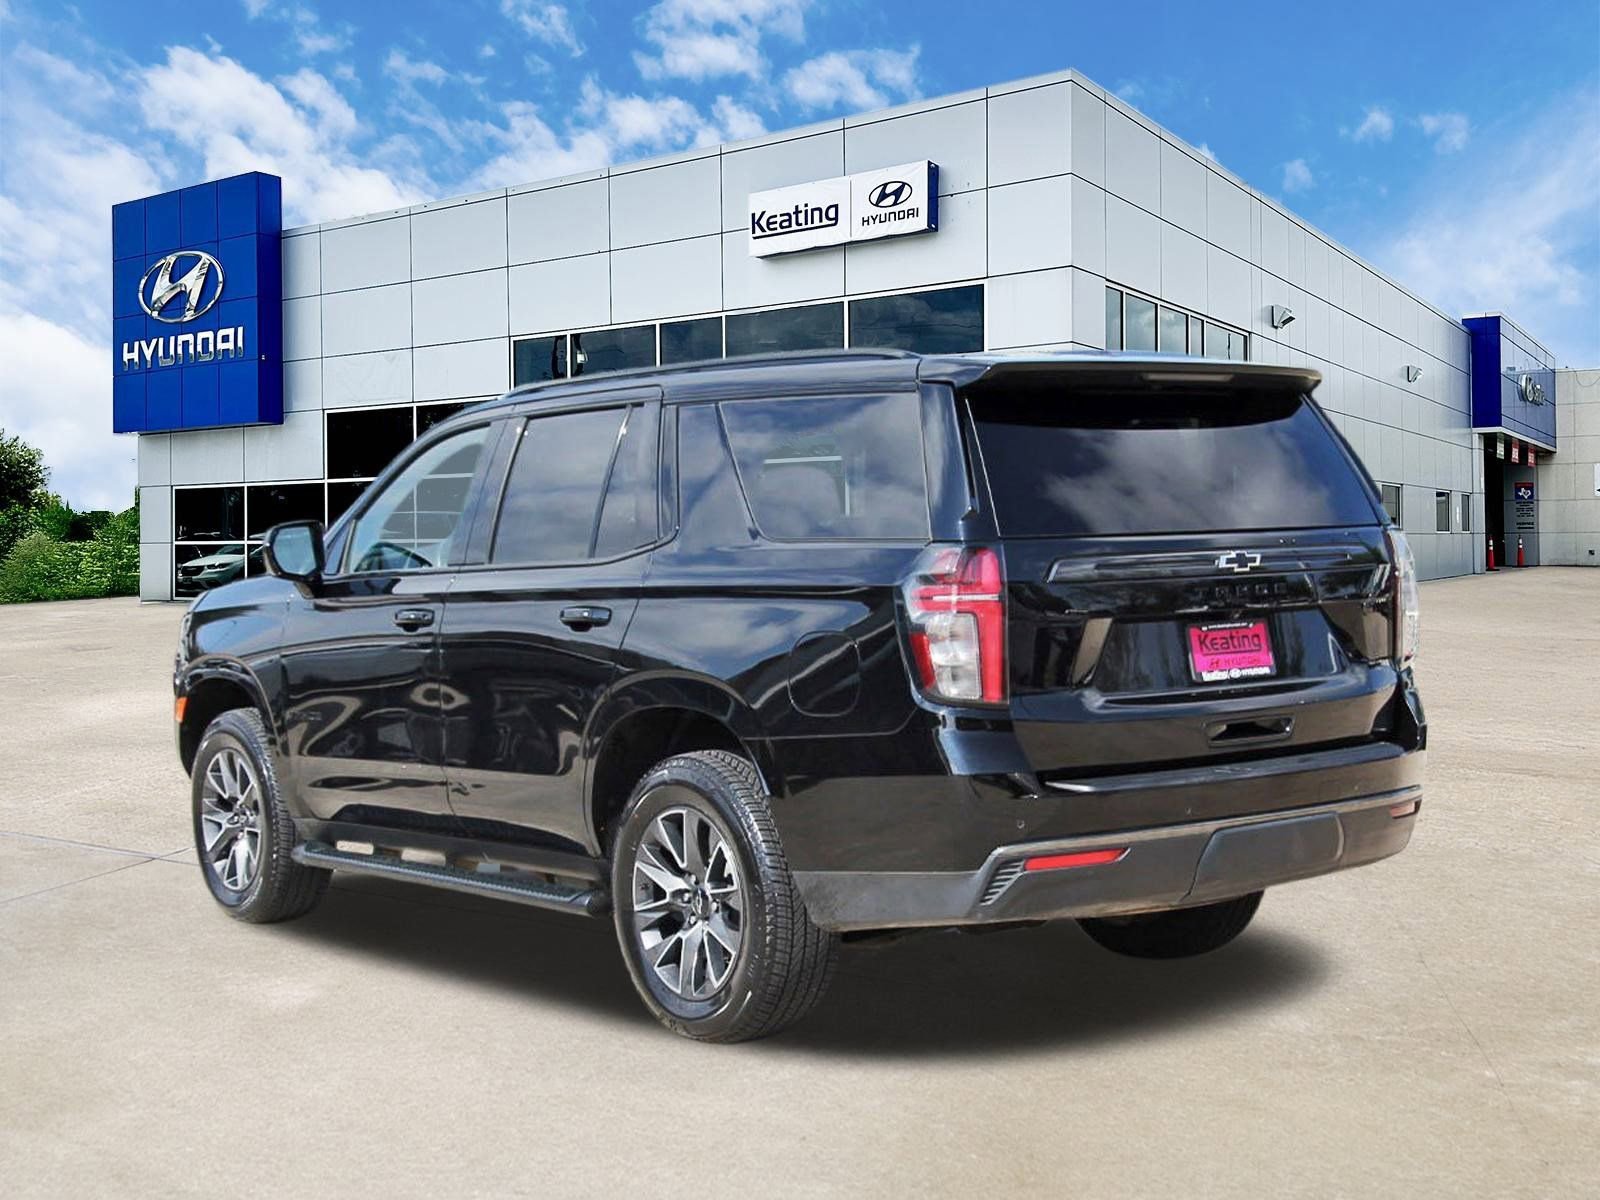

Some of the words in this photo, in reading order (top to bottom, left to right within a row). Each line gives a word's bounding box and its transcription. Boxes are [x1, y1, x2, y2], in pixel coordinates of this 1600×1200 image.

[751, 203, 839, 240] Keating
[861, 207, 919, 227] HYUNDAI
[122, 326, 244, 371] HYUNDAI
[1198, 631, 1262, 656] Keating
